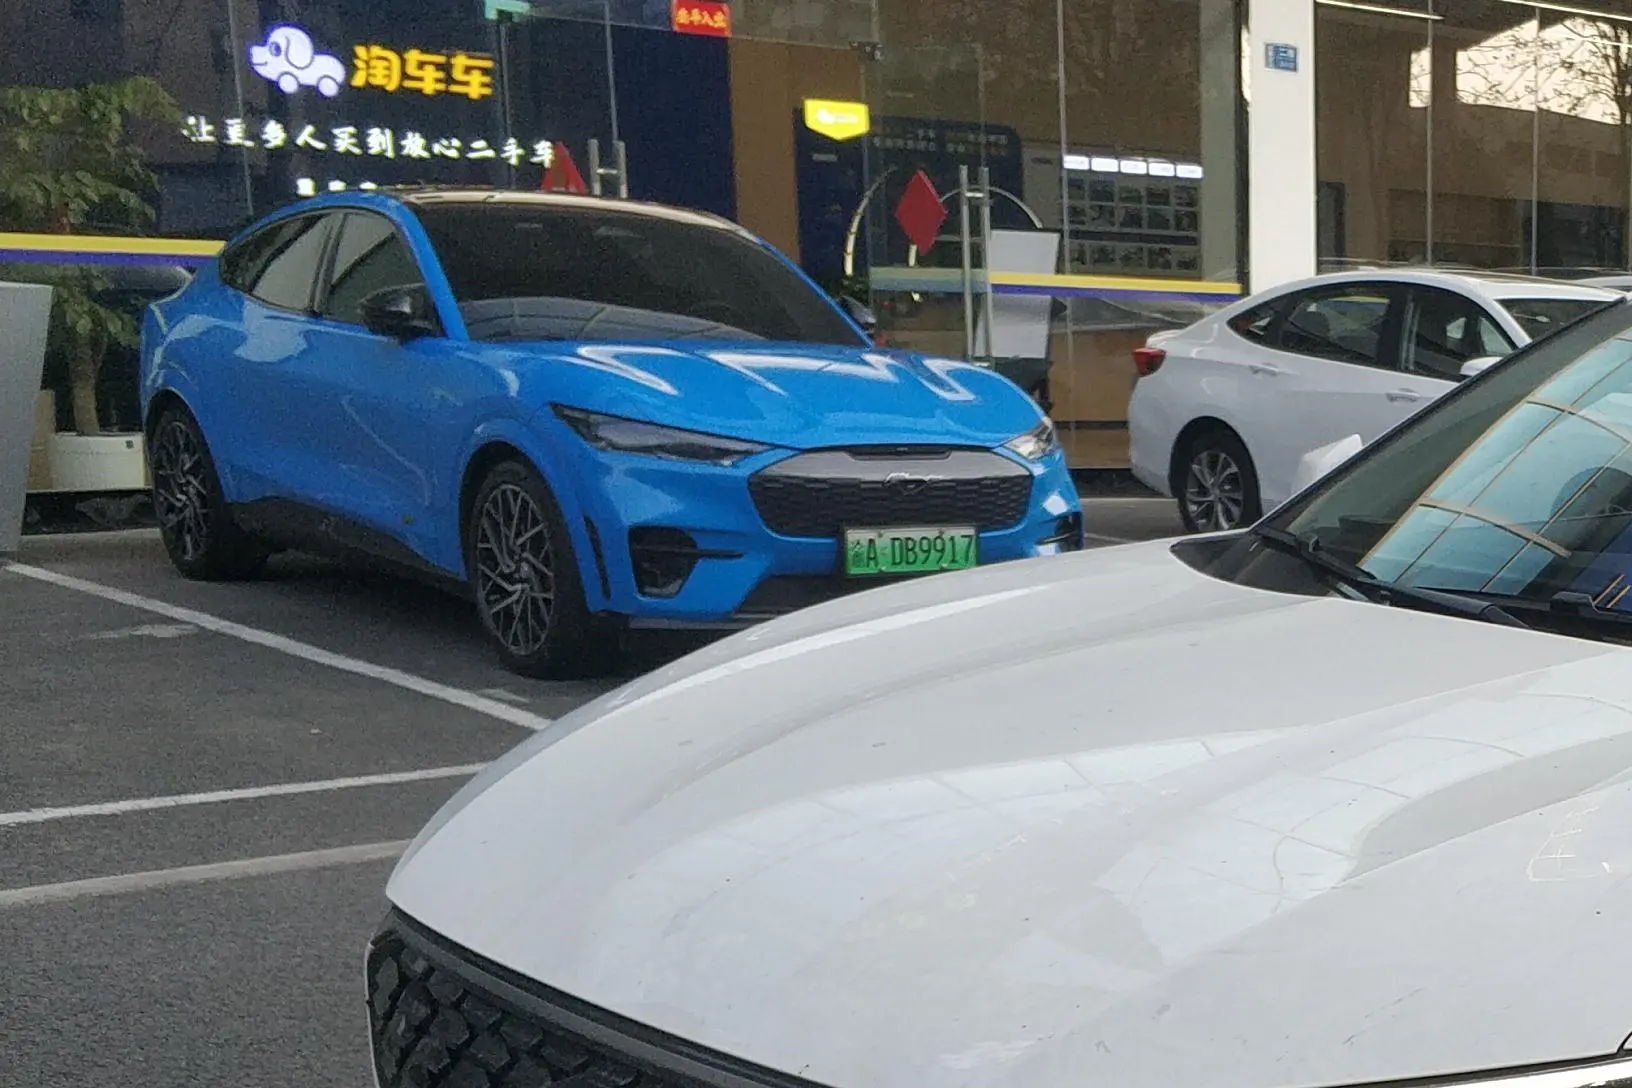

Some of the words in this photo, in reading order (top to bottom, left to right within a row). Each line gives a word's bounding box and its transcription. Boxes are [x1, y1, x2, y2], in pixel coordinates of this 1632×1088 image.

[351, 44, 495, 98] 淘车车
[181, 116, 555, 168] 让更多人买到放心二手车
[890, 535, 973, 566] DB9917
